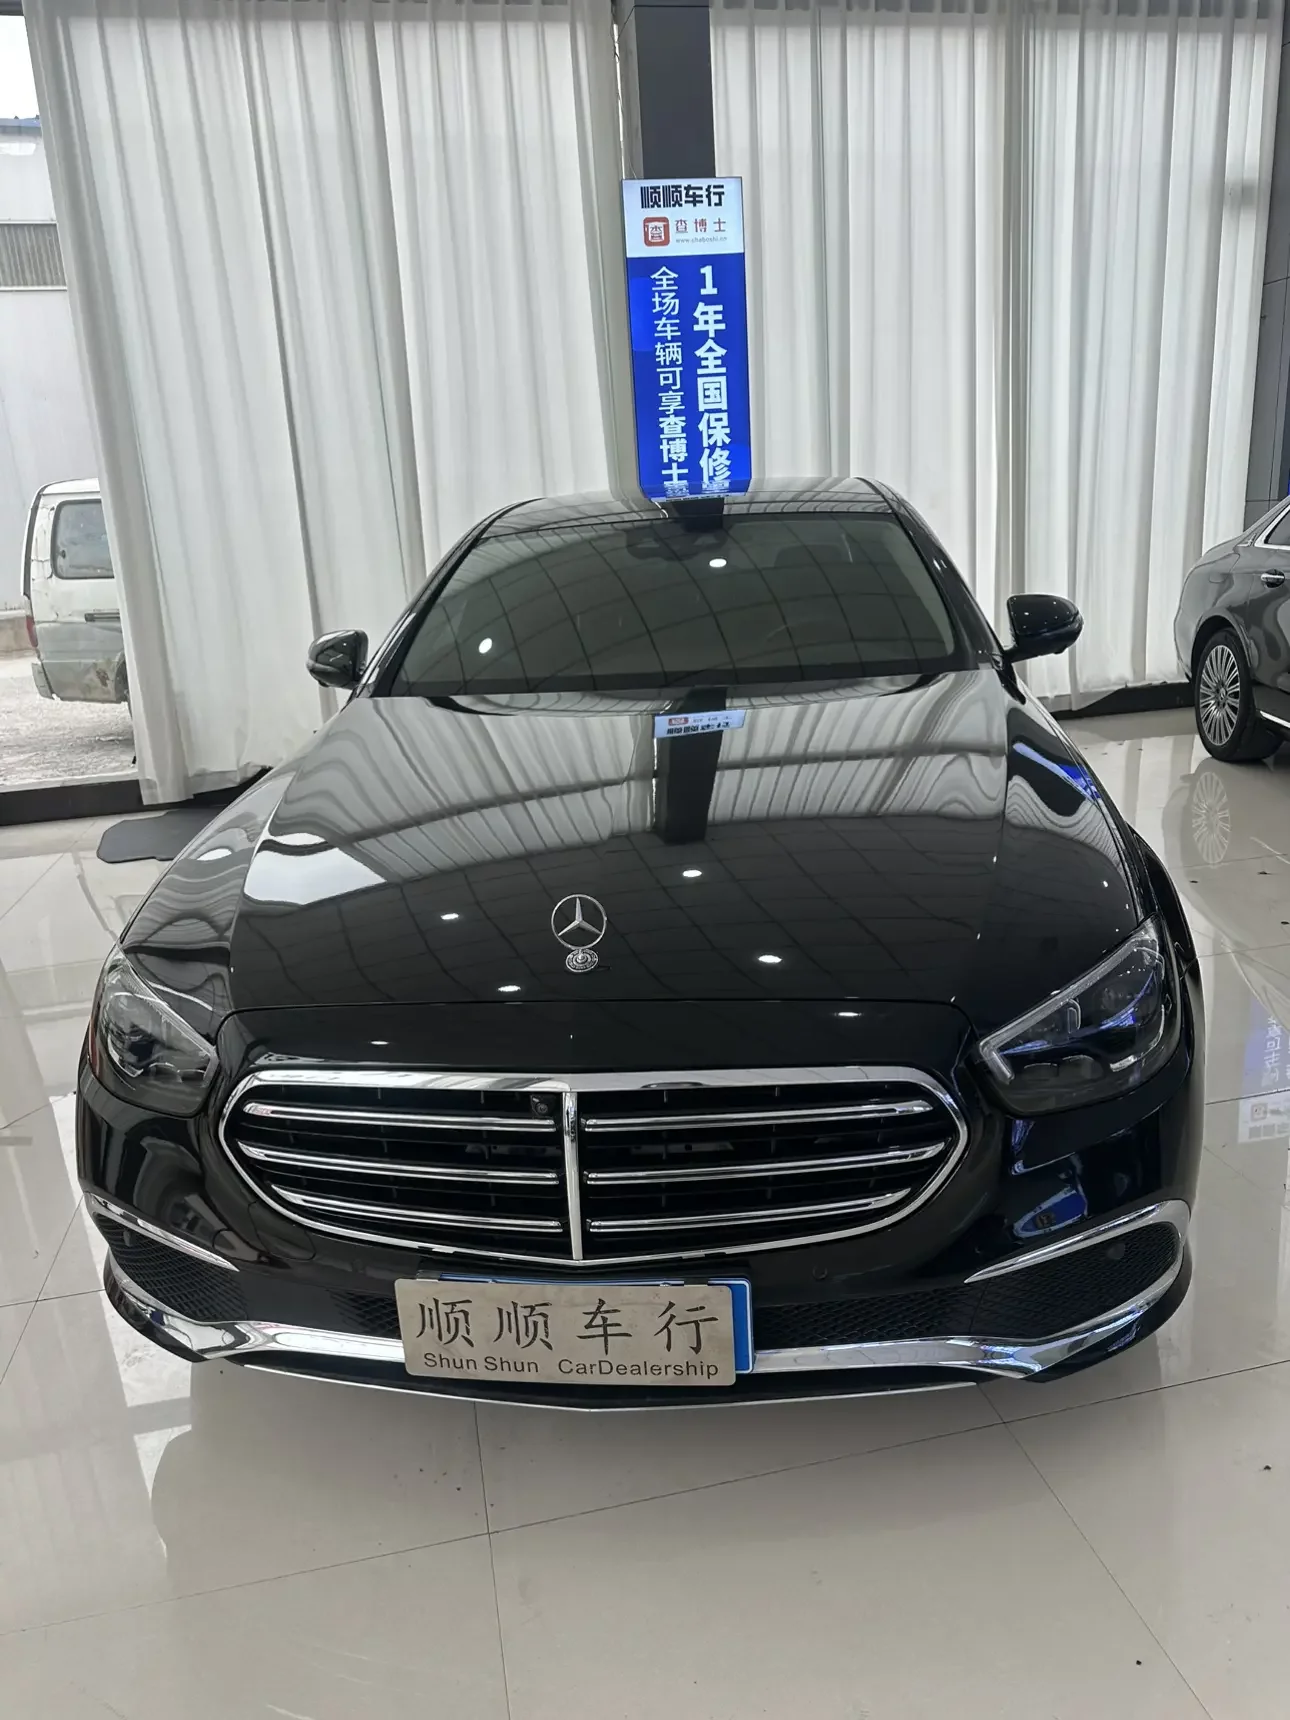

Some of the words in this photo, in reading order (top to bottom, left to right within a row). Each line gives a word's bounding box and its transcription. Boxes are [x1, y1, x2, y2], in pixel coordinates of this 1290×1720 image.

[640, 184, 725, 209] 顺顺车行
[674, 217, 727, 234] 查博士
[650, 266, 689, 485] 全场车辆可享查博士
[693, 265, 732, 484] 1年全国保修
[416, 1297, 719, 1356] 顺顺车行
[424, 1352, 477, 1371] Shun
[484, 1356, 539, 1373] Shun
[557, 1358, 719, 1380] CarDealership
